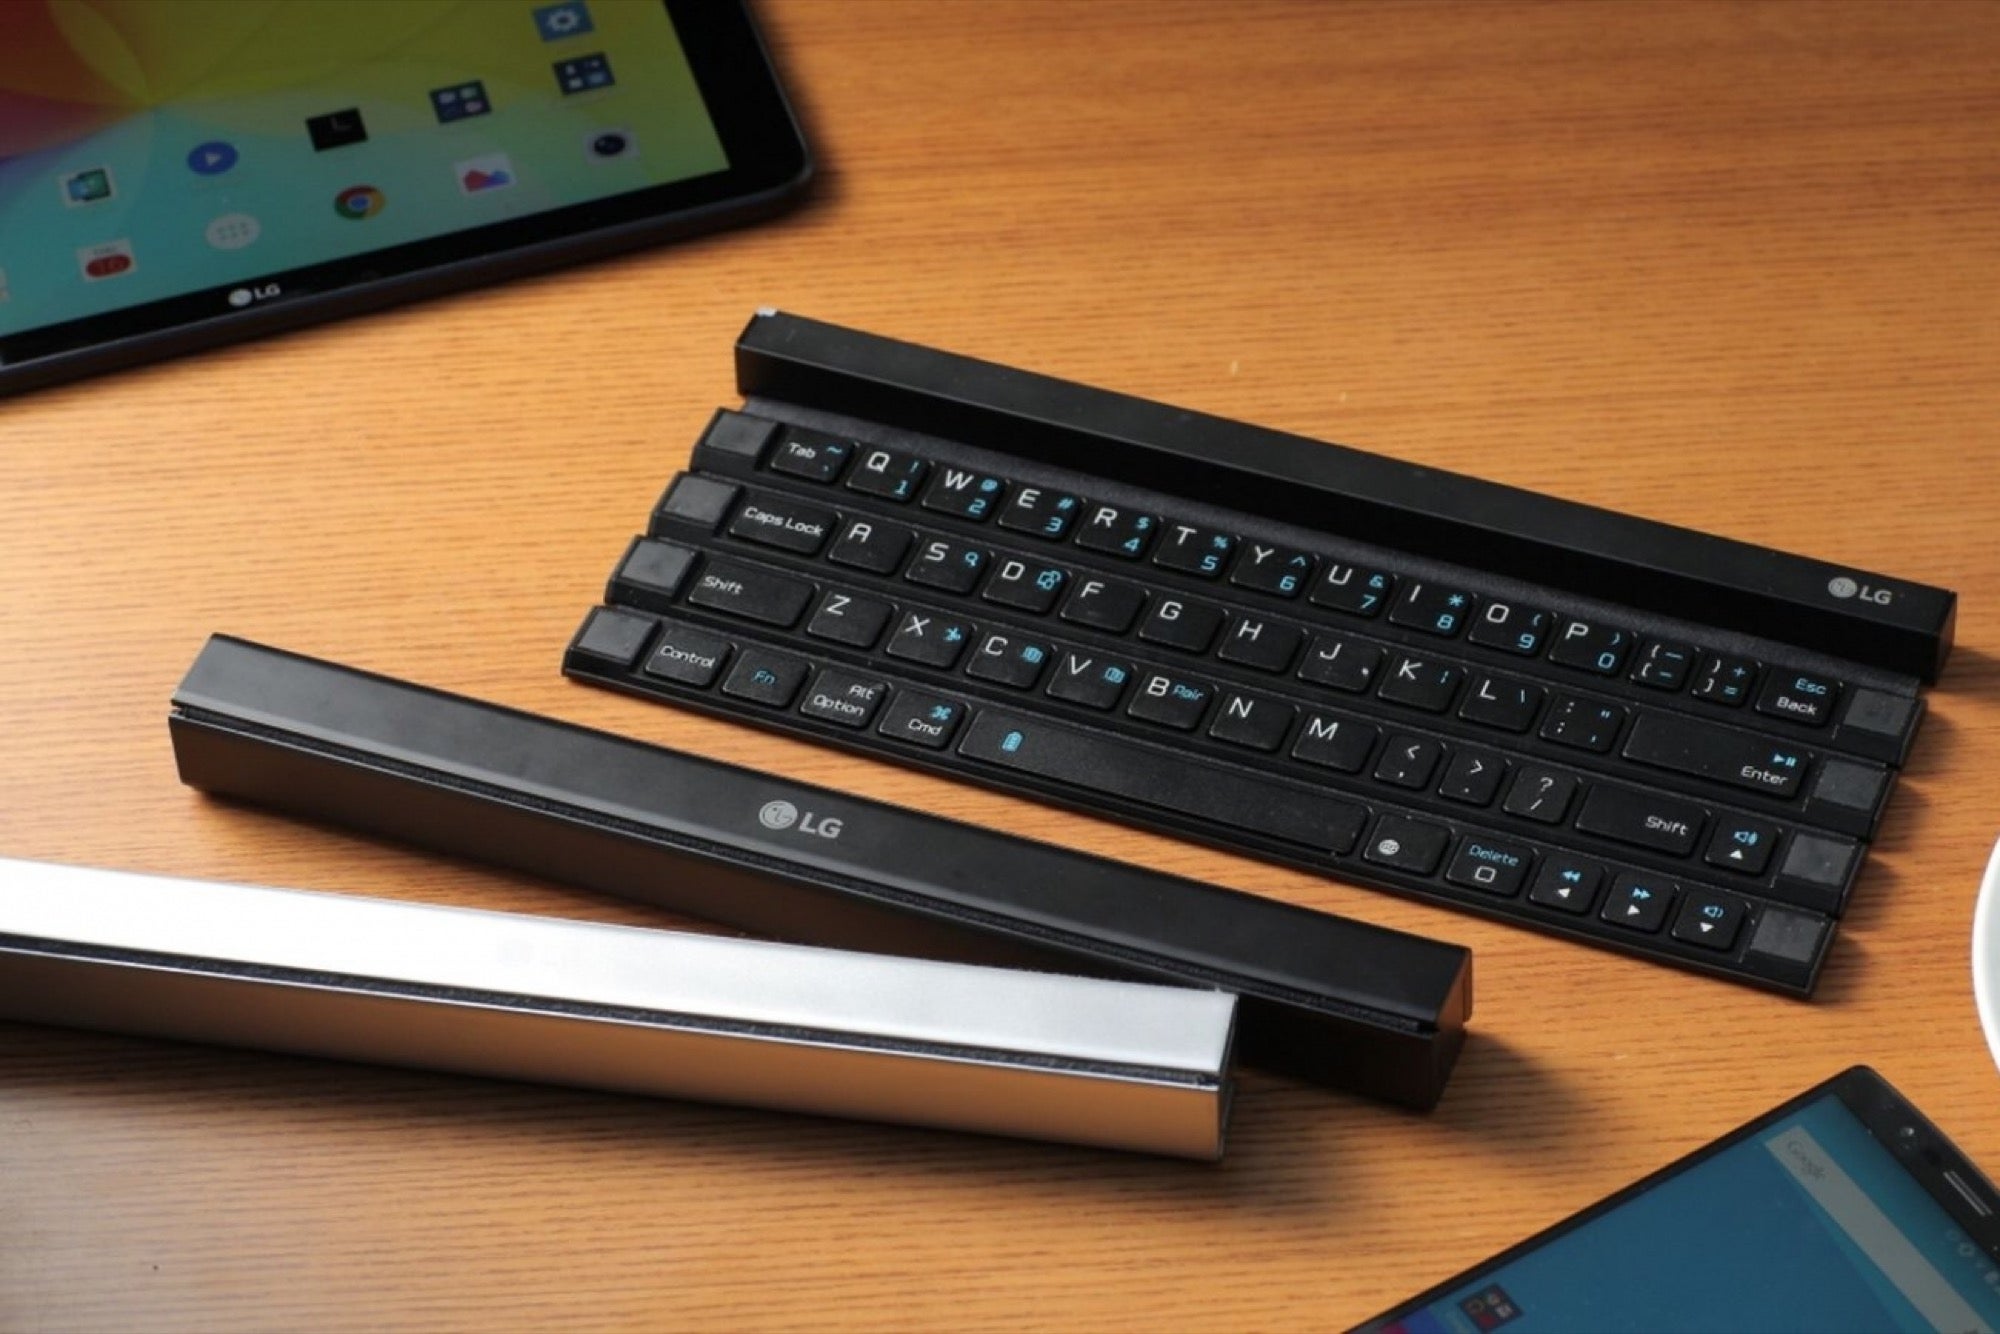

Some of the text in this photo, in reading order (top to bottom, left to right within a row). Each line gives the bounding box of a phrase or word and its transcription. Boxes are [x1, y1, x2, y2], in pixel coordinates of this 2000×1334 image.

[254, 283, 281, 299] LG
[788, 442, 817, 459] Tab
[866, 451, 889, 472] Q
[894, 480, 908, 495] 1
[944, 469, 974, 490] W
[968, 499, 986, 514] 2
[1017, 489, 1041, 509] E
[743, 506, 823, 537] Caps Lock
[1045, 517, 1063, 532] 3
[1093, 507, 1118, 528] R
[849, 522, 872, 543] A
[1175, 525, 1197, 545] T
[925, 542, 950, 562] S
[1123, 537, 1141, 551] 4
[1201, 555, 1219, 571] 5
[1254, 545, 1275, 565] Y
[1001, 561, 1025, 580] D
[1328, 565, 1353, 585] U
[703, 575, 743, 595] Shift
[1080, 581, 1104, 598] F
[1279, 576, 1296, 591] 6
[1409, 584, 1421, 602] I
[826, 595, 851, 616] Z
[1361, 594, 1377, 609] 7
[1859, 585, 1892, 606] LG
[1159, 601, 1183, 620] G
[1486, 603, 1509, 623] O
[904, 616, 930, 637] X
[1238, 620, 1263, 641] H
[1437, 614, 1454, 630] 8
[1565, 622, 1589, 640] P
[985, 636, 1009, 655] C
[1319, 642, 1342, 660] J
[1517, 633, 1535, 649] 9
[660, 645, 716, 668] Control
[1070, 655, 1093, 675] V
[753, 669, 776, 685] Fn
[1399, 659, 1422, 681] K
[848, 684, 875, 700] Alt
[1147, 676, 1170, 697] B
[1172, 684, 1204, 700] Pair
[1479, 679, 1497, 700] L
[1794, 678, 1827, 695] Esc
[812, 694, 865, 717] Option
[1228, 696, 1254, 718] N
[1776, 697, 1818, 716] Back
[908, 718, 943, 736] Cmd
[1308, 717, 1339, 741] M
[1539, 777, 1554, 793] ?
[1740, 765, 1789, 786] Enter
[799, 812, 843, 838] LG
[1645, 815, 1689, 836] Shift
[1468, 844, 1520, 867] Delete
